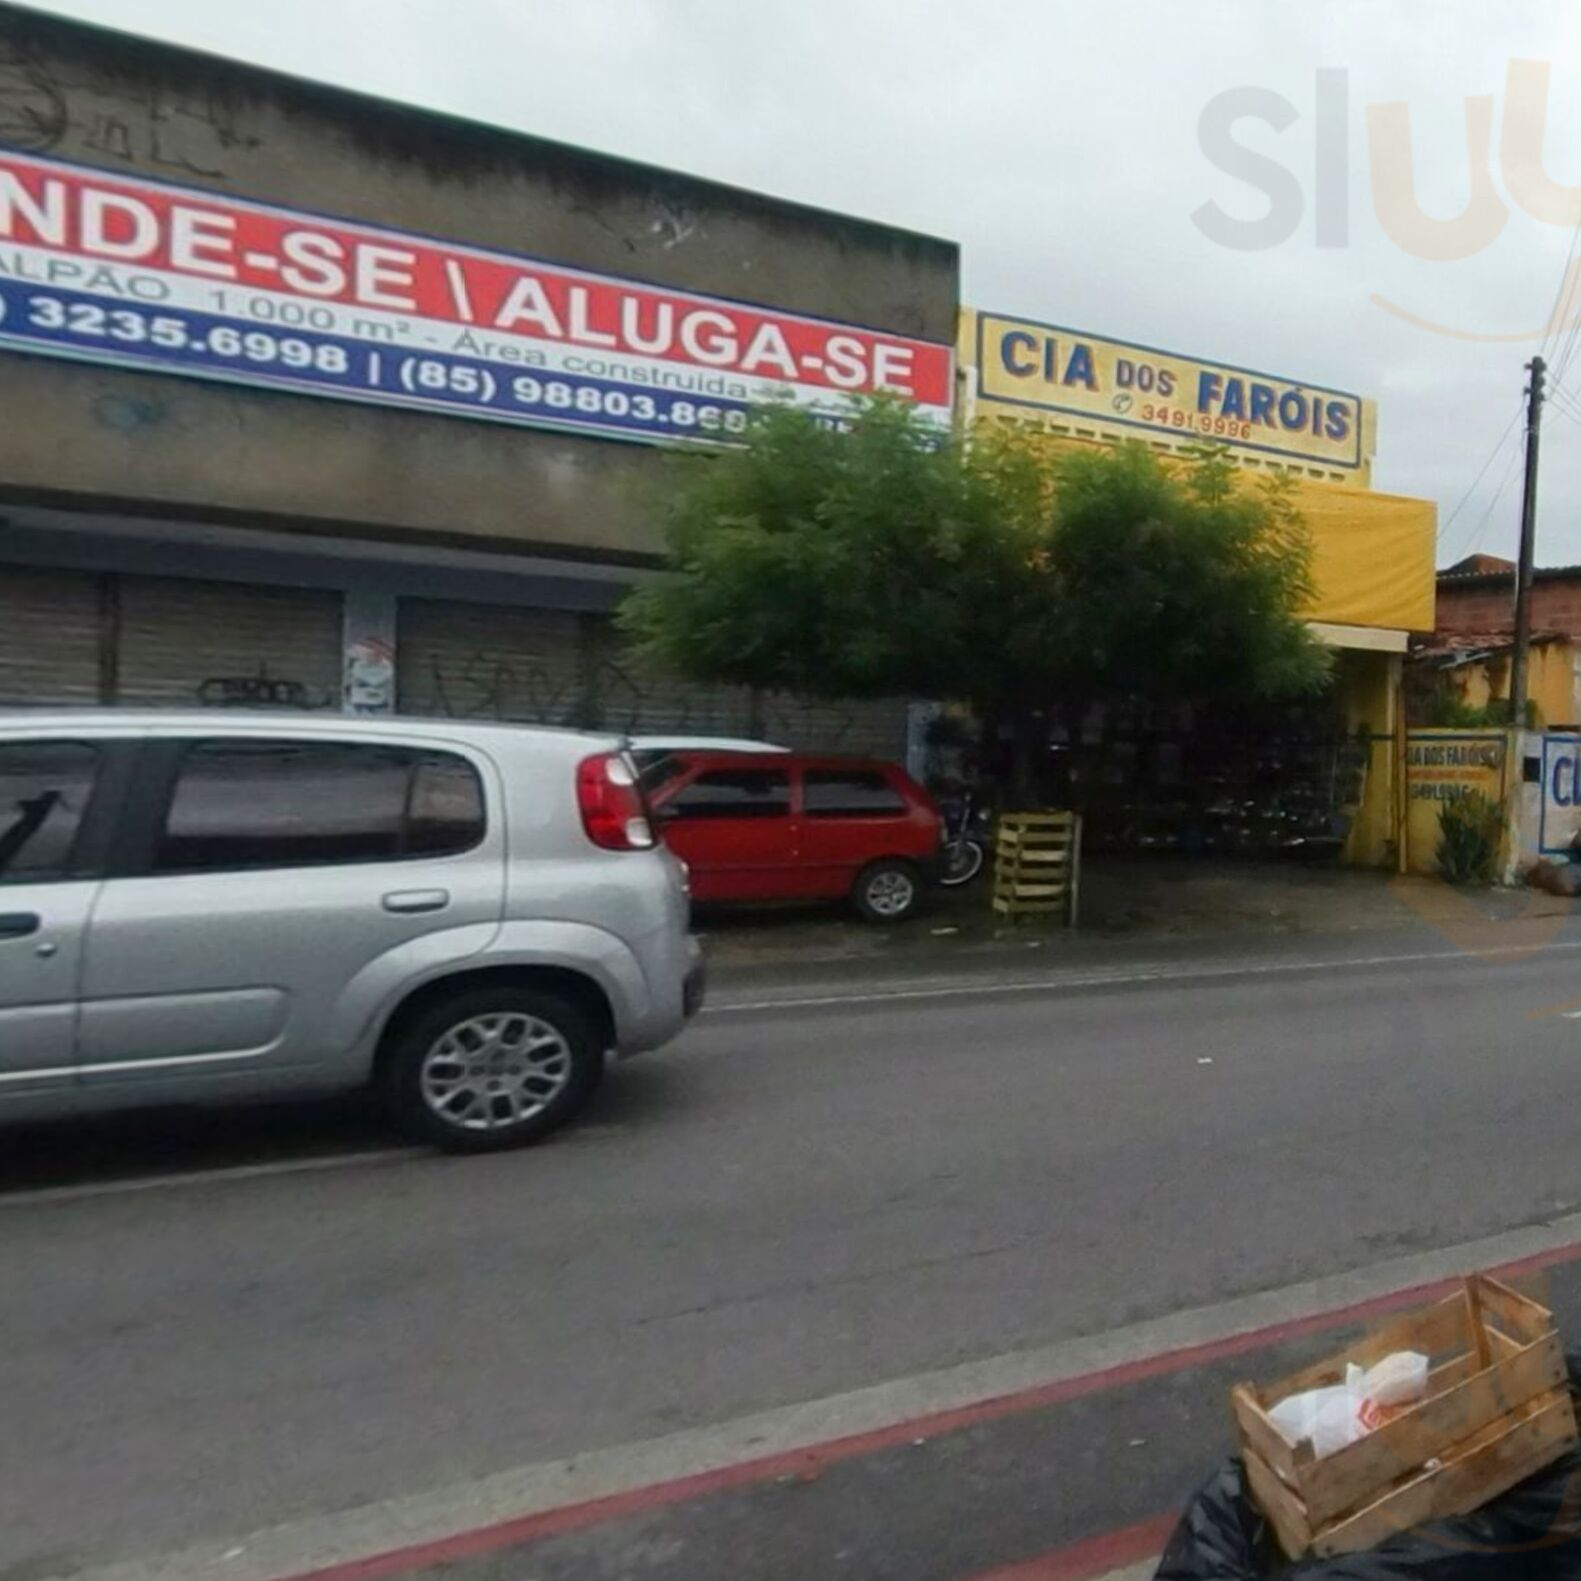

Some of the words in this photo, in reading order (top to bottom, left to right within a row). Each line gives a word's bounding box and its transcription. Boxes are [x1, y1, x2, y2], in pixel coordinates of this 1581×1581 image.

[28, 297, 348, 375] 3235.6998
[400, 358, 497, 403] (85)
[208, 289, 336, 330] 1.000
[494, 276, 914, 396] ALUGA-SE
[1000, 330, 1100, 392] CIA
[1115, 358, 1178, 398] DOS
[1197, 366, 1352, 442] FARÓIS
